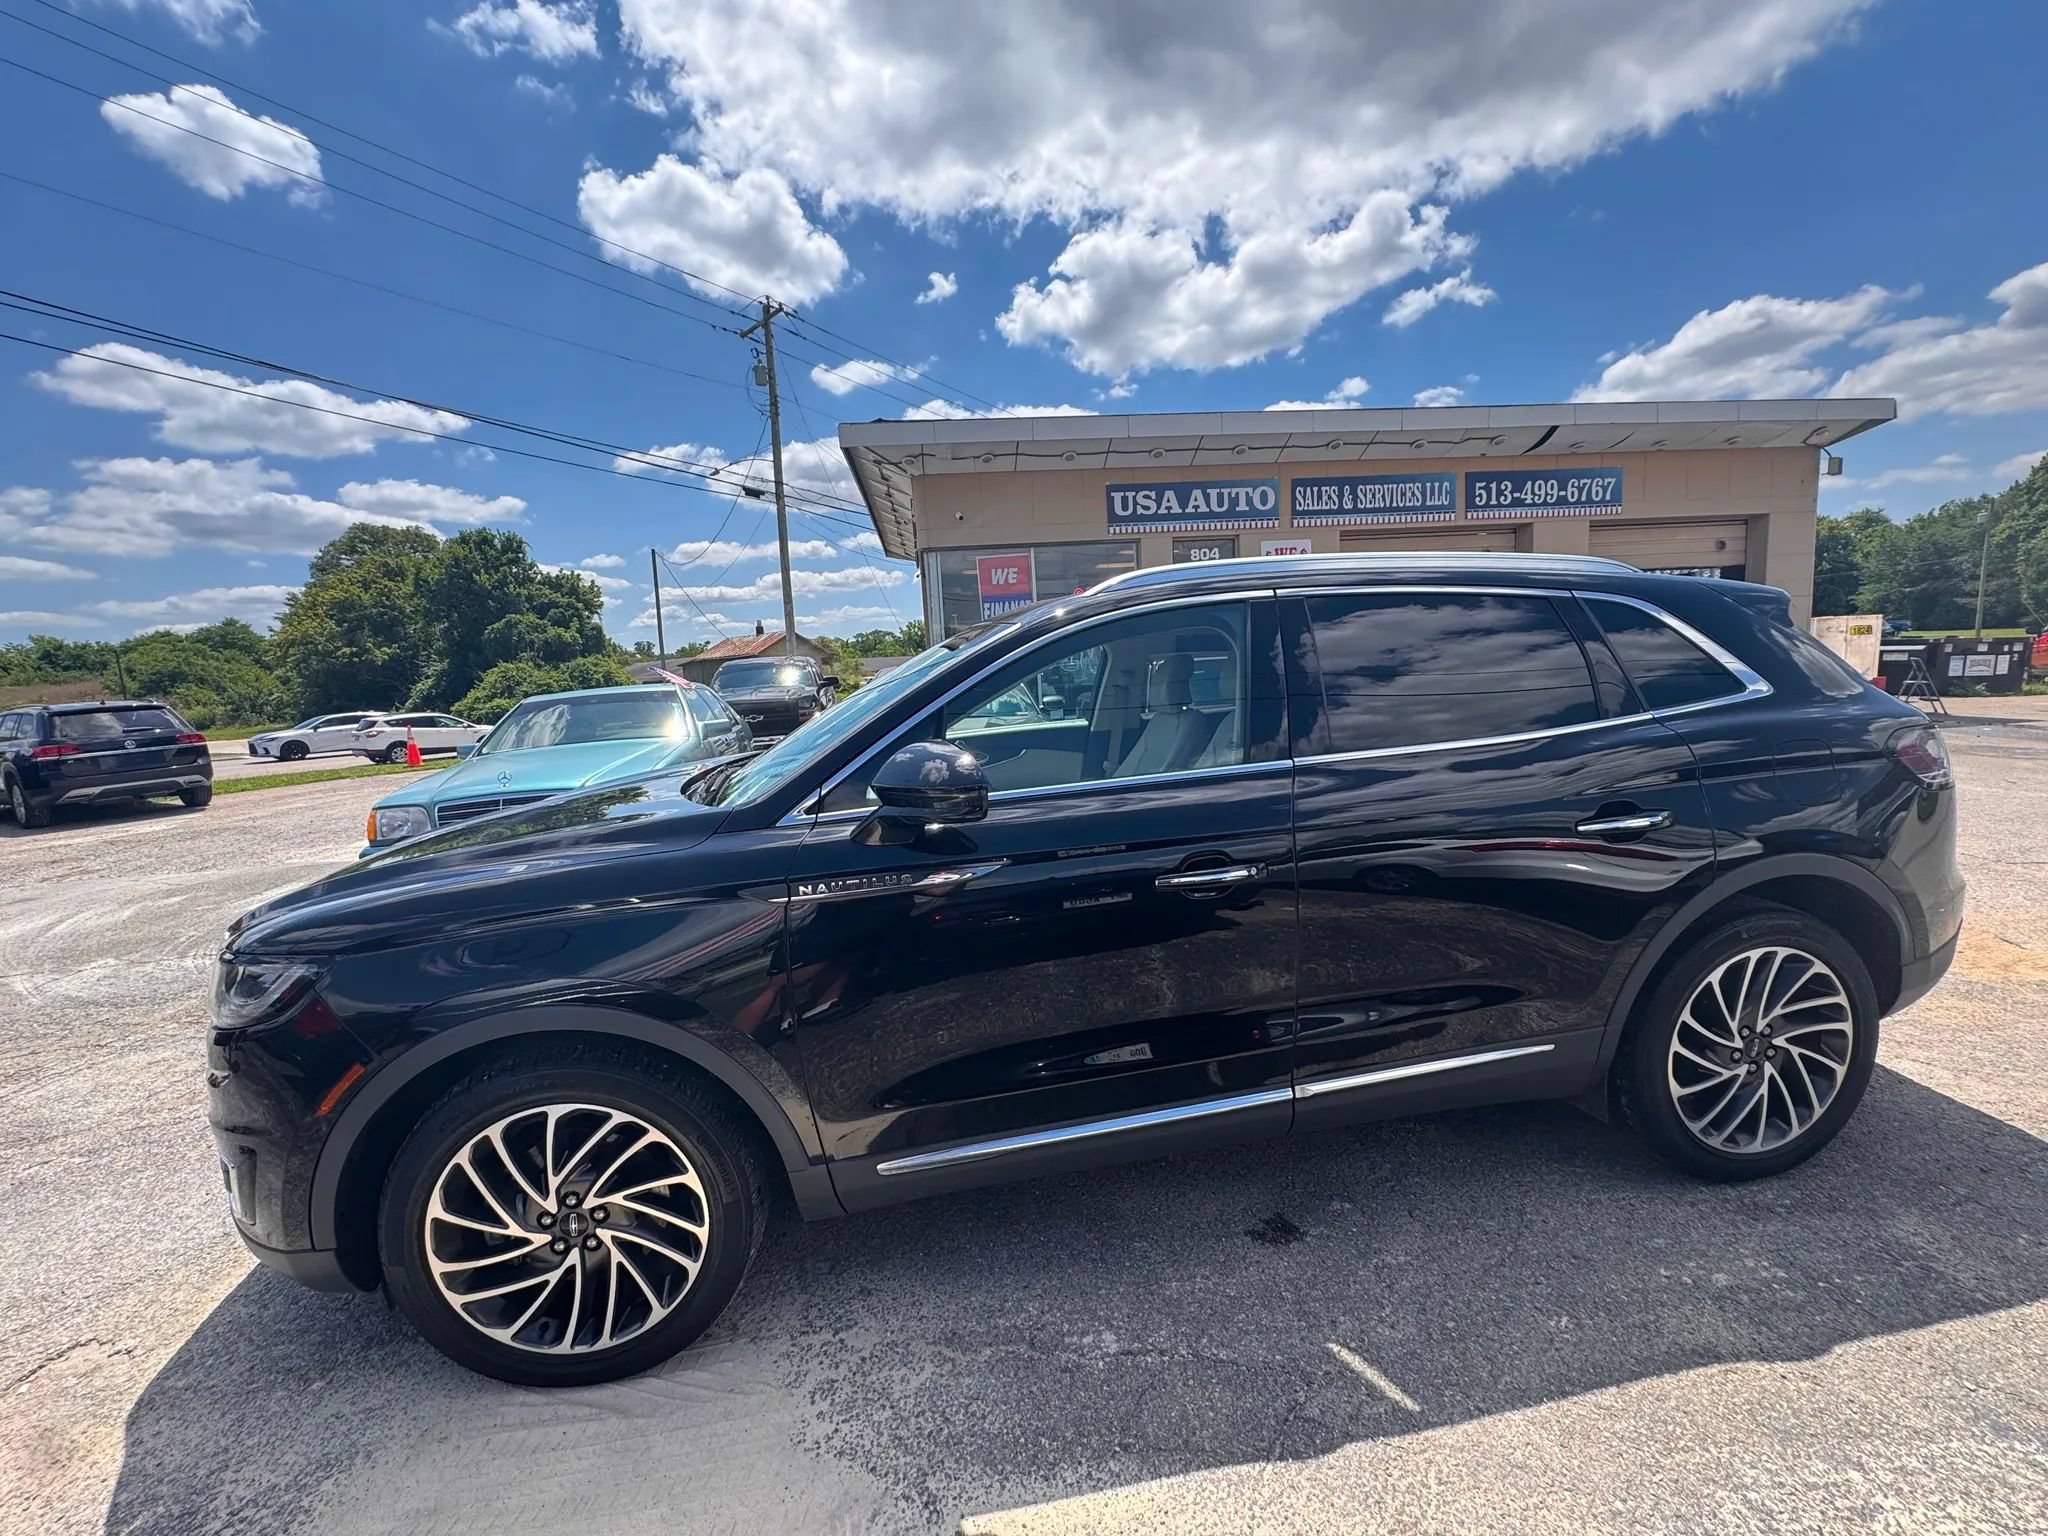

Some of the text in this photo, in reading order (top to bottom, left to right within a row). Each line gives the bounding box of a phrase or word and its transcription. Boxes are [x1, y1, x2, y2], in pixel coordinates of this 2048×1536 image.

[1111, 486, 1275, 516] USA AUTO
[1296, 481, 1450, 510] SALES & SERVICES LLC
[1475, 478, 1616, 505] 513-499-6767
[1190, 548, 1220, 560] 804
[991, 567, 1018, 585] WE
[798, 873, 913, 896] NAUTILUS
